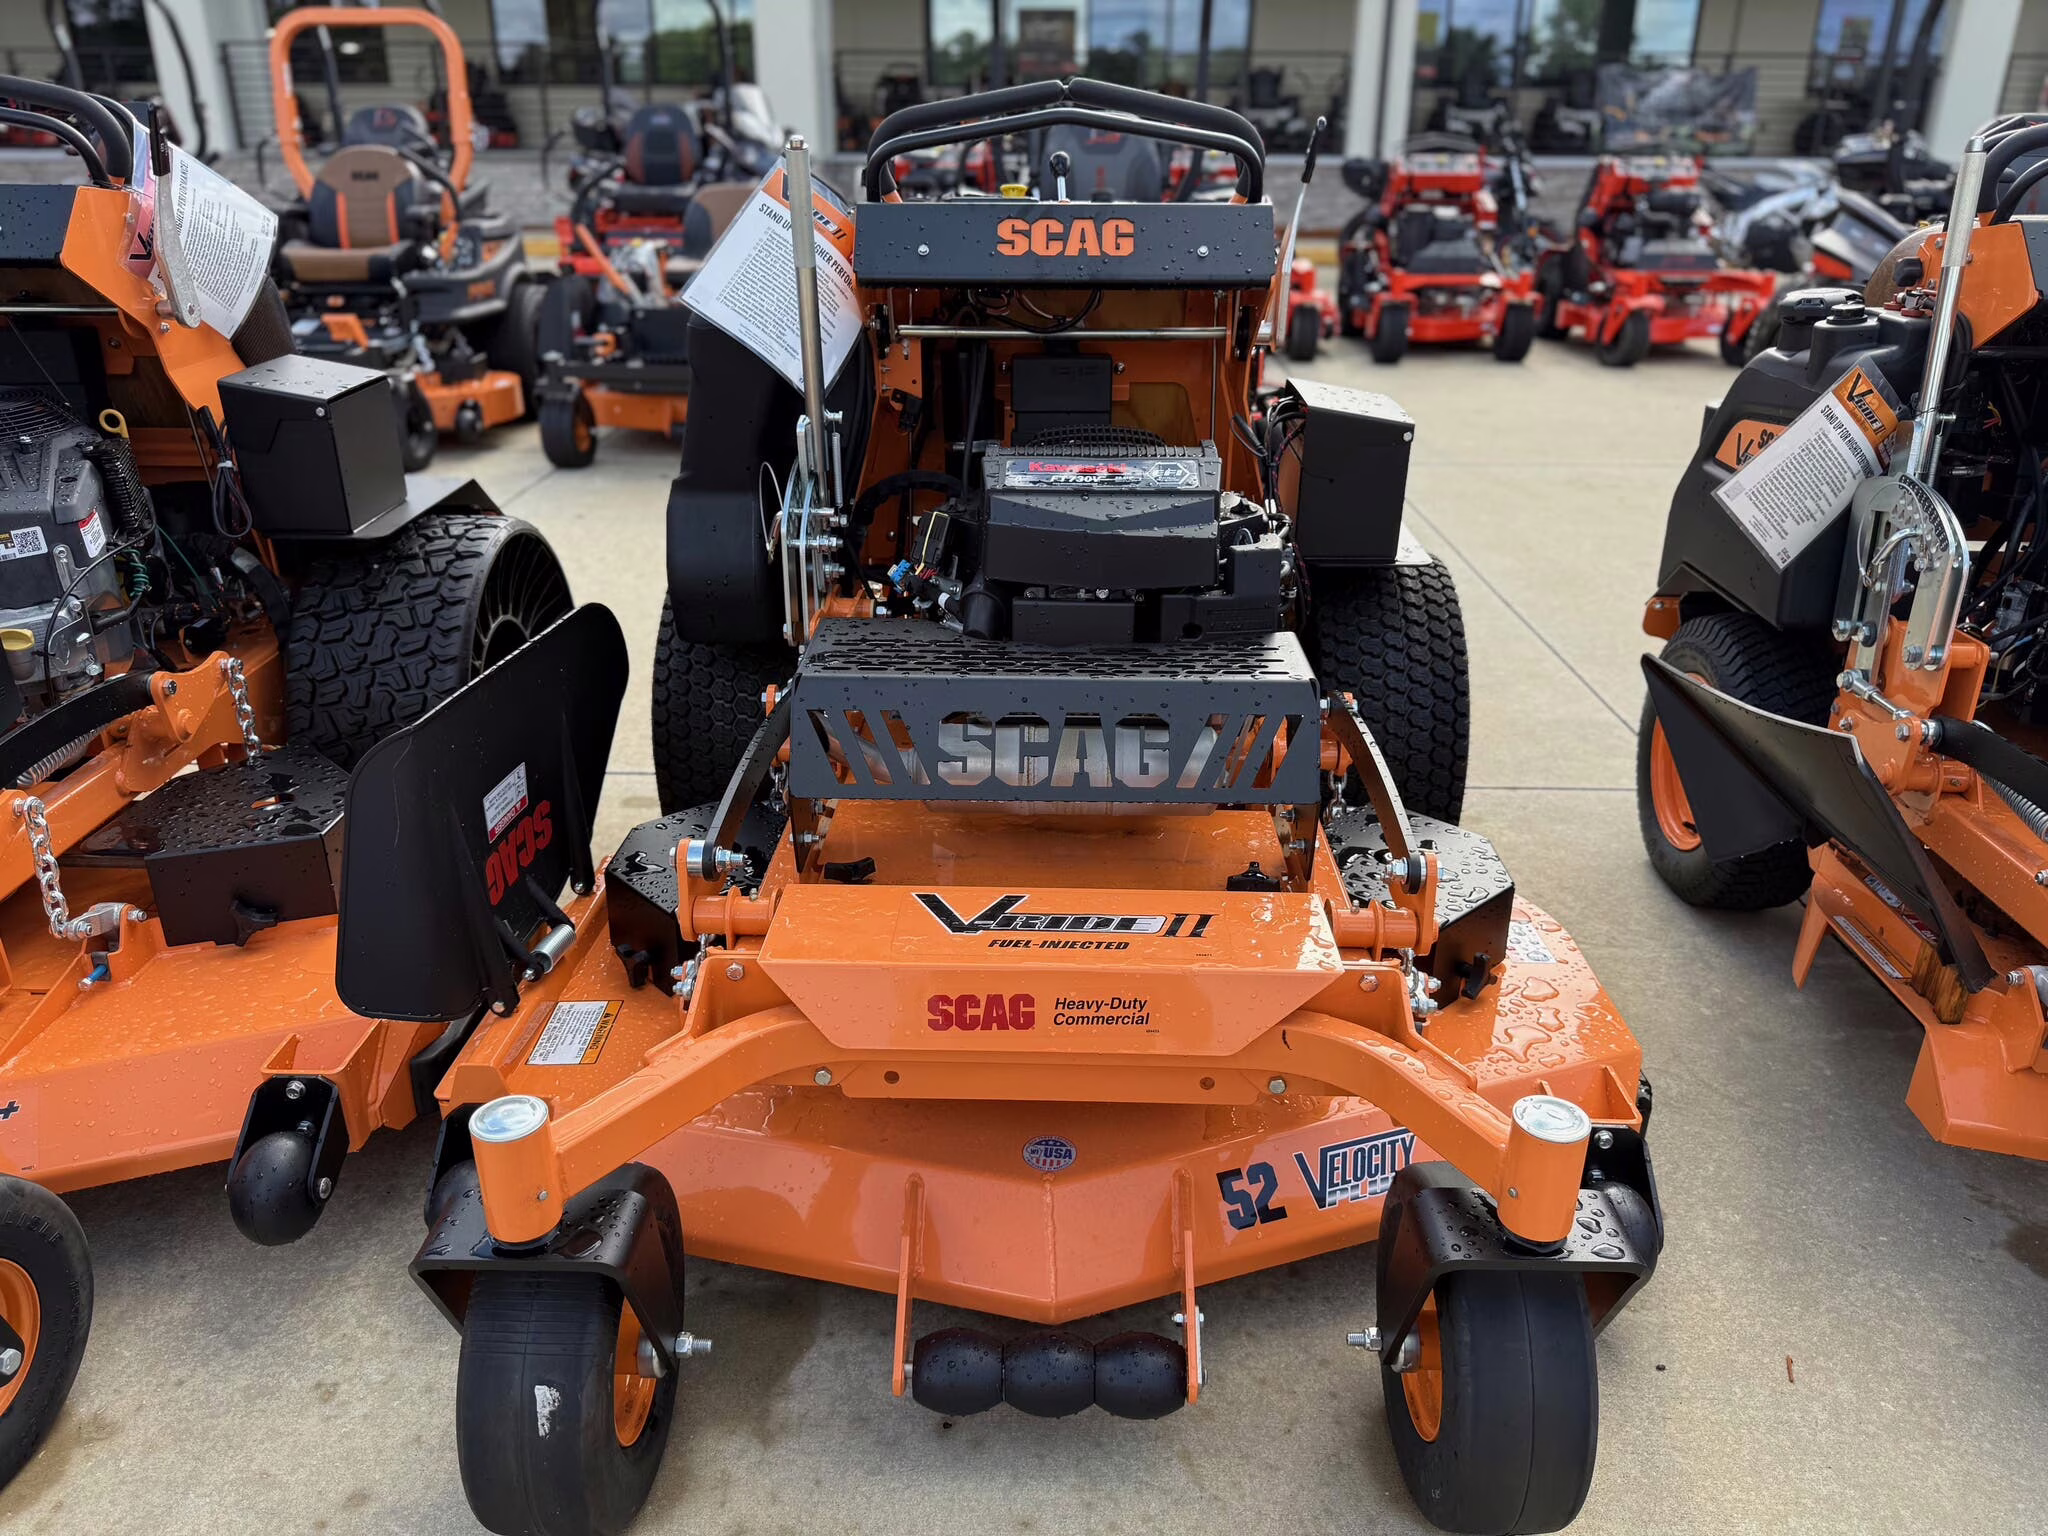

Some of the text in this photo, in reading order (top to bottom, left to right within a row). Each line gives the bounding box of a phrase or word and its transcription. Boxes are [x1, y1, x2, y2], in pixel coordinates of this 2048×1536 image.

[758, 203, 784, 225] STAND
[813, 242, 834, 265] GHER
[996, 217, 1135, 257] SCAG
[1820, 404, 1839, 426] STAND
[1832, 419, 1845, 432] UP
[1837, 427, 1852, 443] FOR
[937, 710, 1170, 788] SCAG
[485, 799, 553, 907] SCAG
[987, 938, 1131, 951] FUEL-INJECTED
[927, 993, 1036, 1031] SCAG
[1052, 1012, 1150, 1026] Commercial
[1053, 997, 1148, 1013] Heavy-Duty
[1042, 1146, 1073, 1160] USA
[1292, 1126, 1417, 1210] VELOCITY
[1215, 1161, 1288, 1231] 52
[1326, 1172, 1395, 1208] PLU
